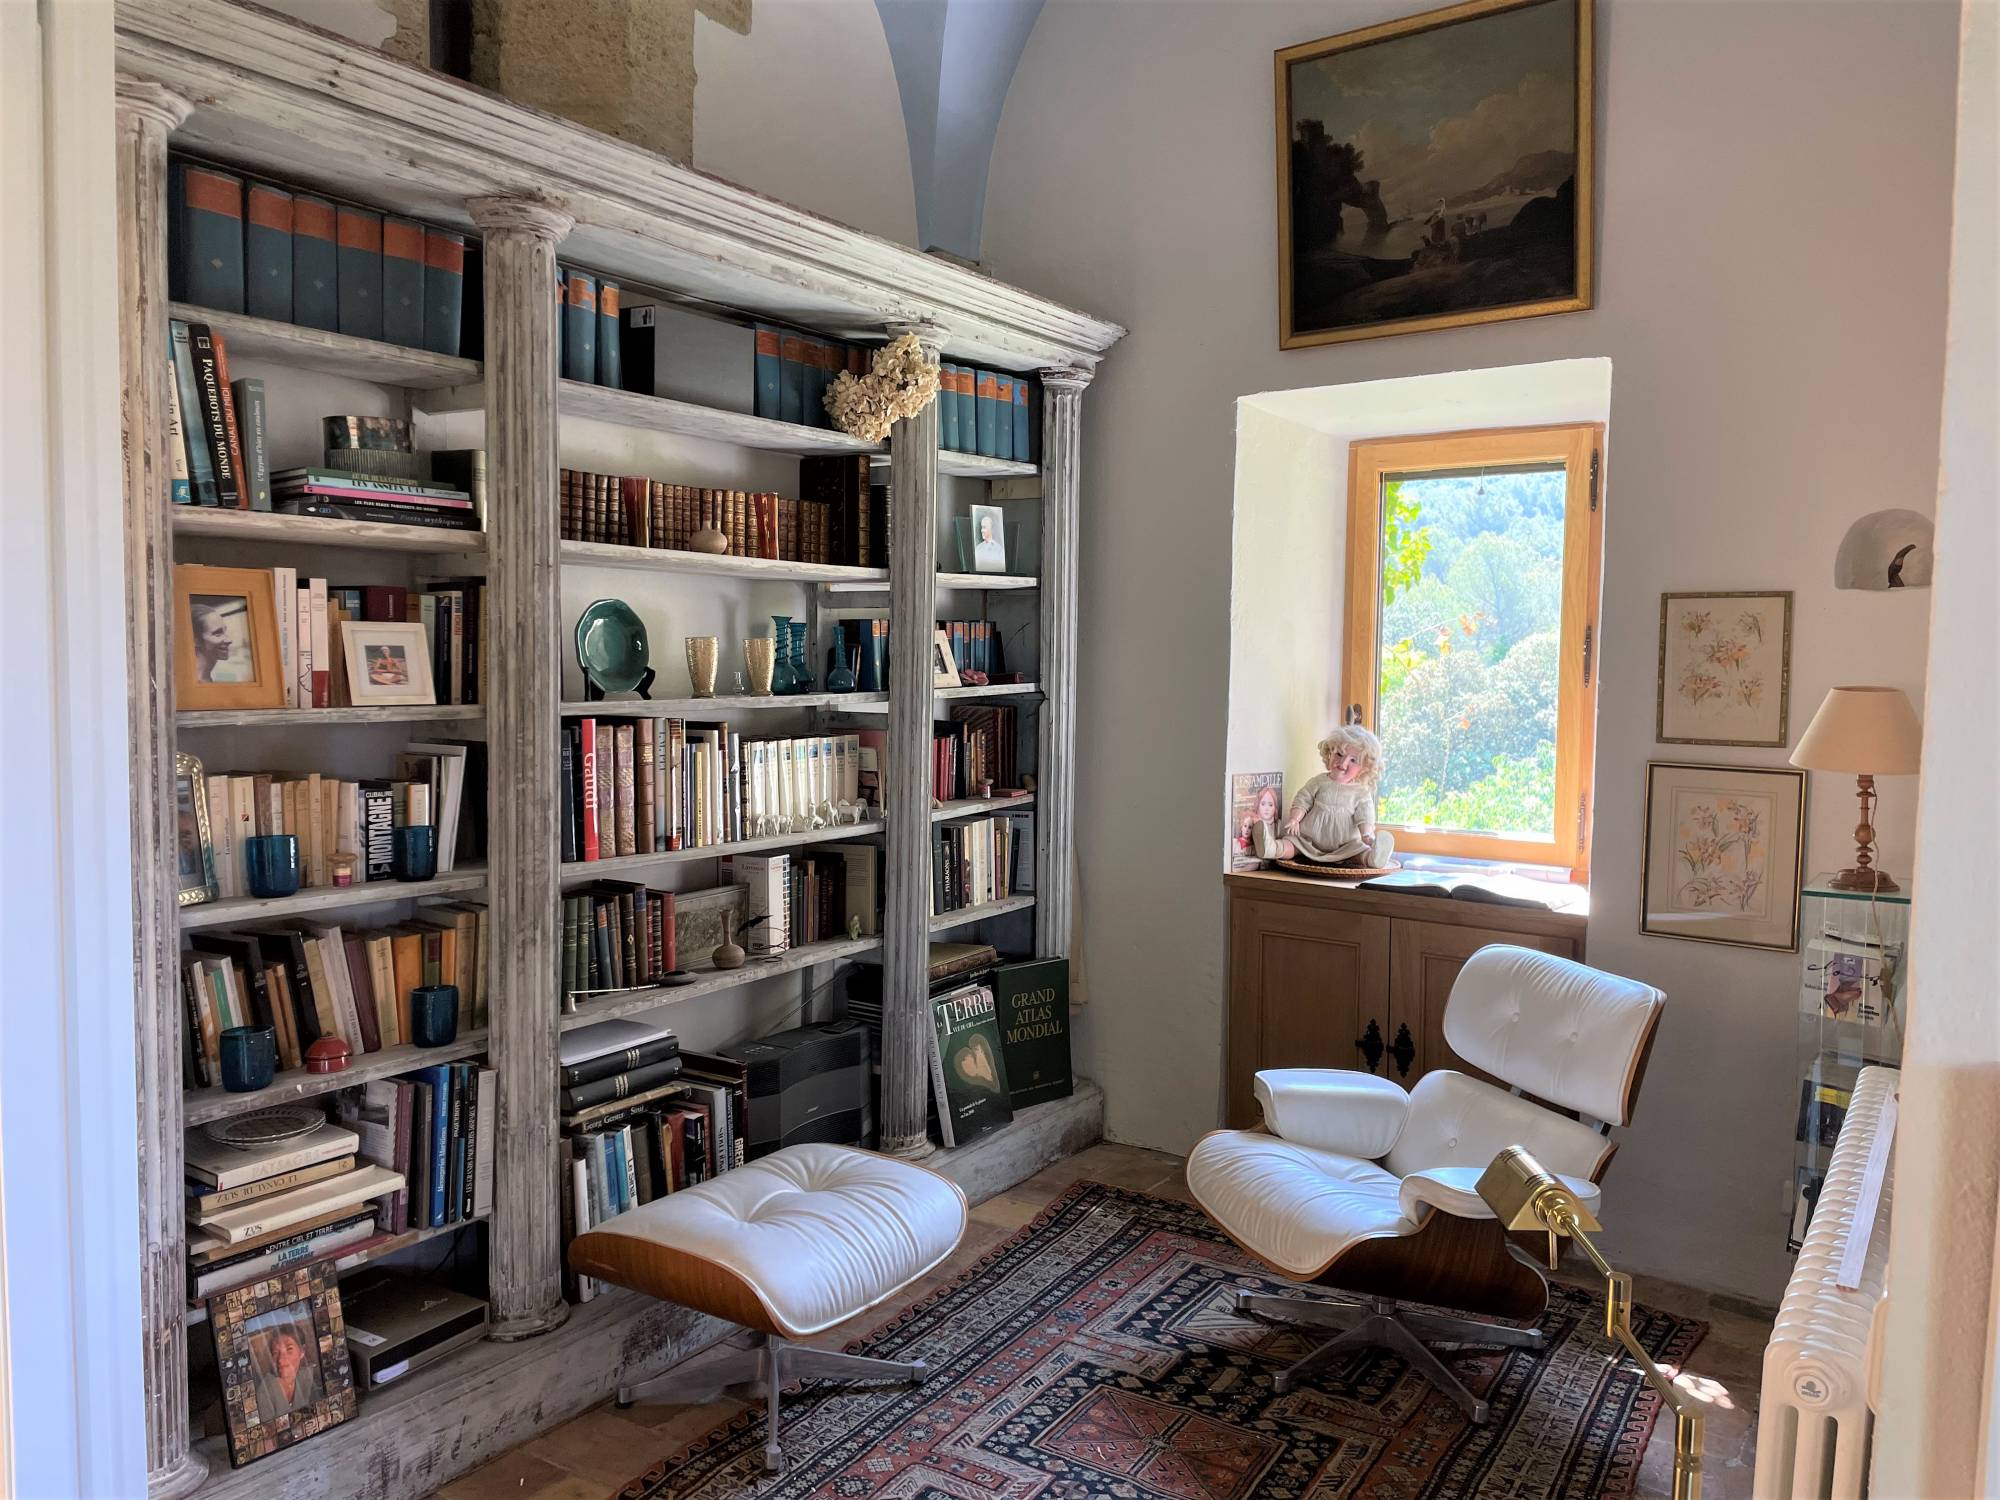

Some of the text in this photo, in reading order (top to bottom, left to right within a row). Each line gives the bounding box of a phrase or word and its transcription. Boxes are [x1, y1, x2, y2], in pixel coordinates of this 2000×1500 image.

[221, 388, 232, 407] MIDI
[202, 358, 231, 479] PAQUEBOTS DU MONDE
[224, 408, 234, 422] DU
[227, 426, 239, 456] CANAL
[368, 797, 393, 875] LA MONTAGNE
[1010, 987, 1056, 1009] GRAND
[937, 990, 994, 1036] TERRE
[1015, 1005, 1053, 1026] ATLAS
[1006, 1020, 1063, 1045] MONDIAL
